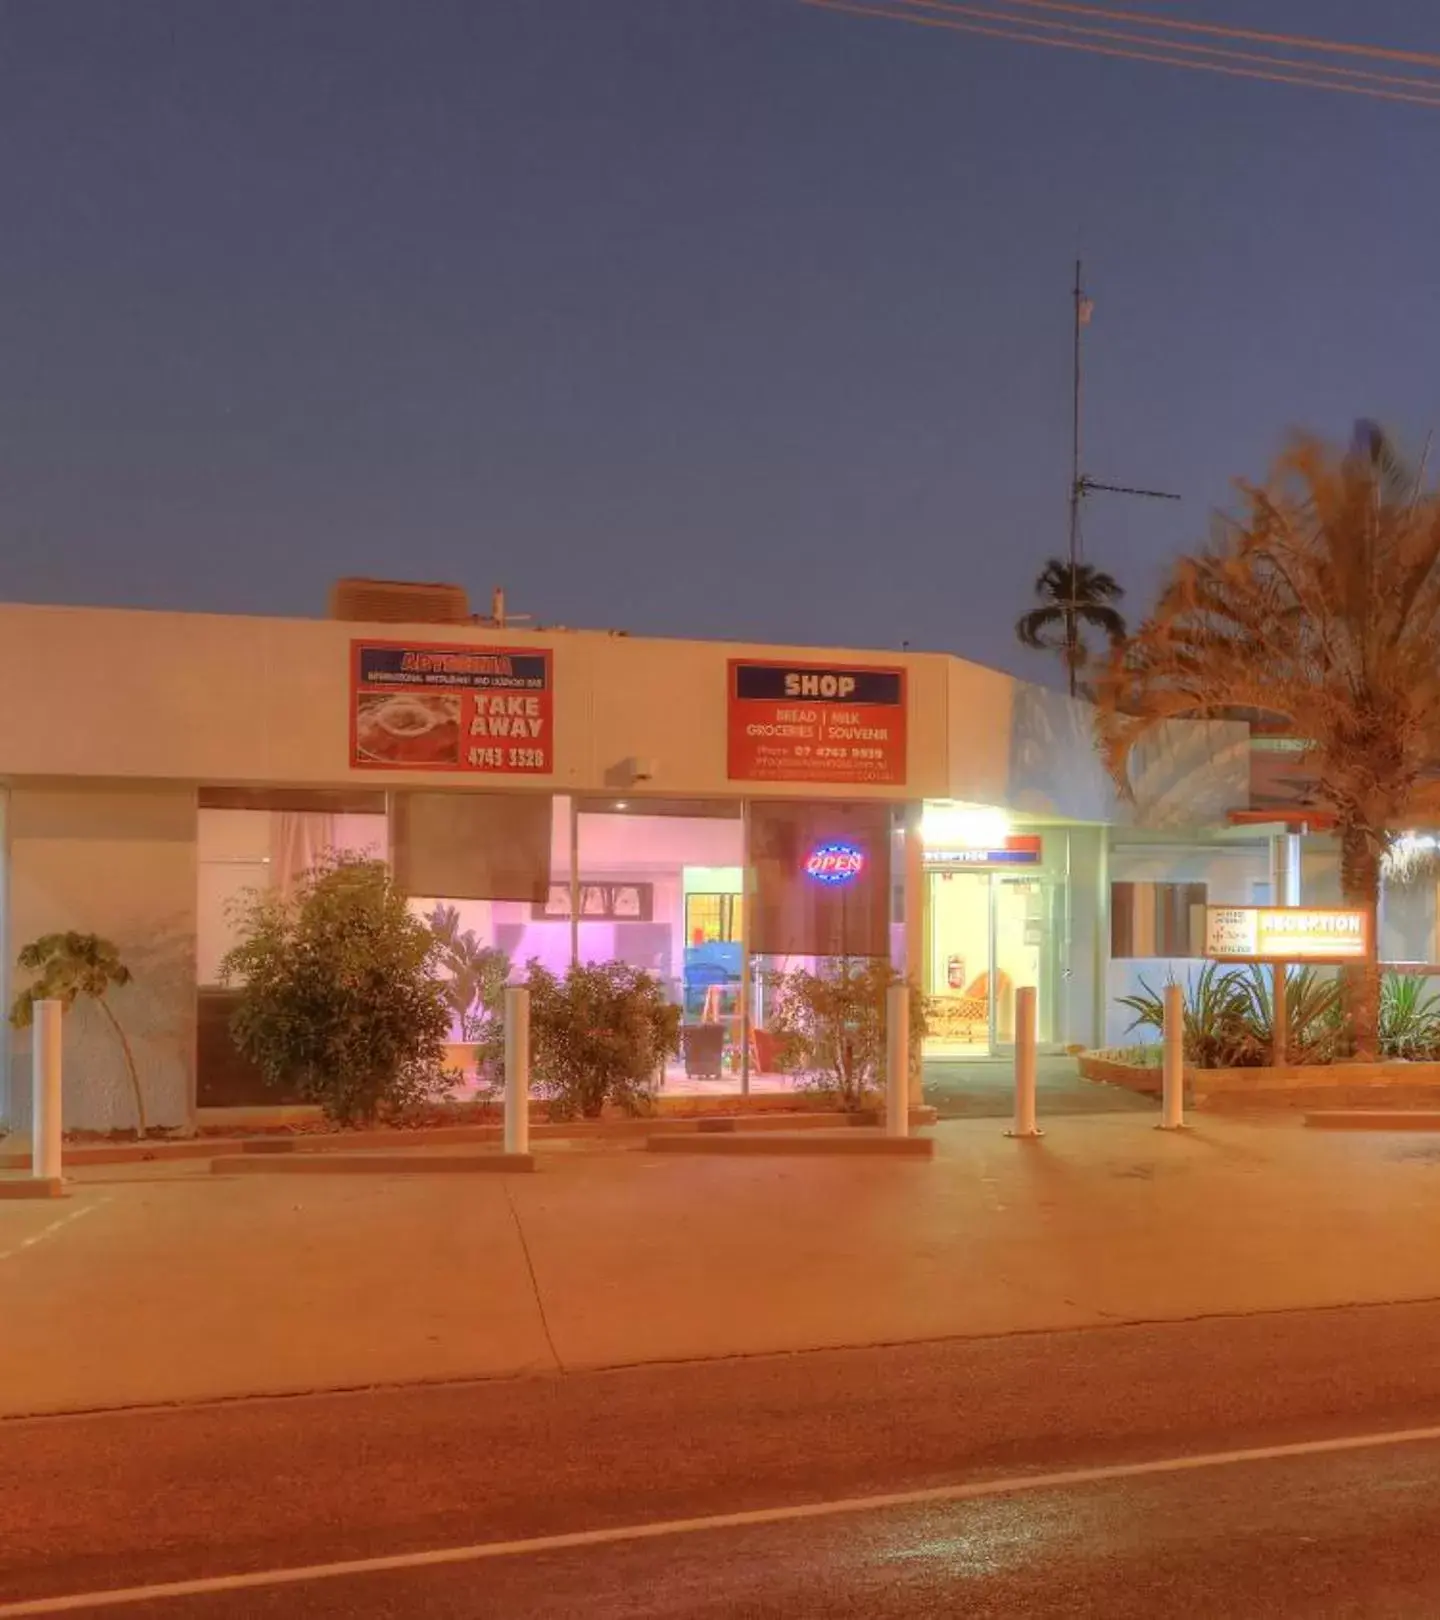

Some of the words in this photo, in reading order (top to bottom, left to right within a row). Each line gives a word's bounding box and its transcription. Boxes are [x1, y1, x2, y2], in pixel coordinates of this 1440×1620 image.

[784, 673, 856, 698] SHOP
[474, 694, 539, 716] TAKE
[775, 709, 818, 723] BREAD
[470, 716, 544, 738] AWAY
[746, 724, 814, 738] GROCERIES
[828, 725, 889, 741] SOUVENIR
[807, 853, 863, 872] OPEN
